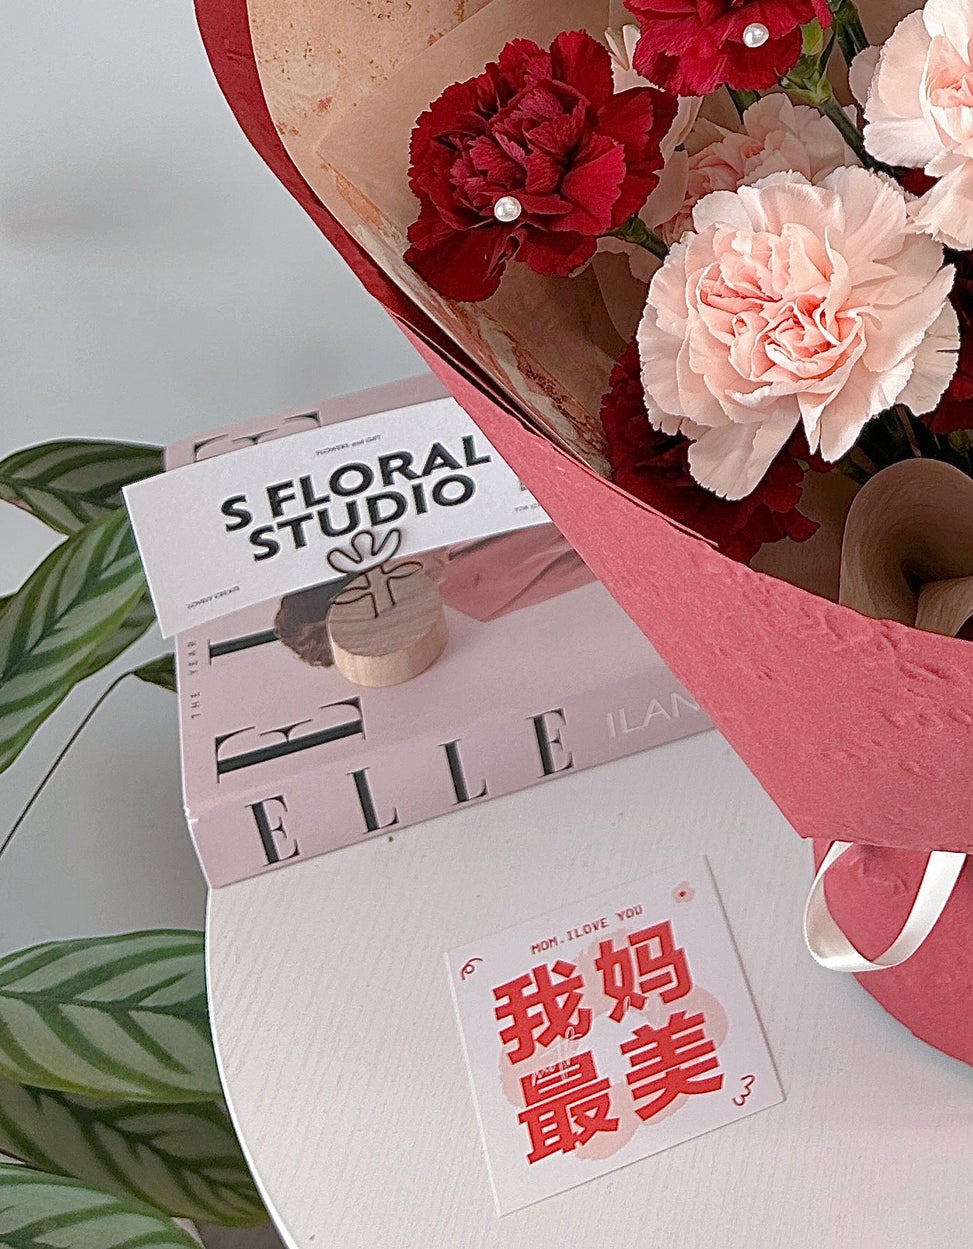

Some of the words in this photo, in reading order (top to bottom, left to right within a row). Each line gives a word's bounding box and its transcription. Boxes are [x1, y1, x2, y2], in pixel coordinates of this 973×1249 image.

[220, 495, 252, 532] S
[266, 434, 492, 518] FLORAL
[249, 473, 477, 562] STUDIO
[190, 692, 201, 719] THE
[245, 707, 574, 867] ELLE
[616, 904, 644, 921] YOU
[492, 919, 694, 1065] 我妈
[517, 1010, 725, 1165] 最美
